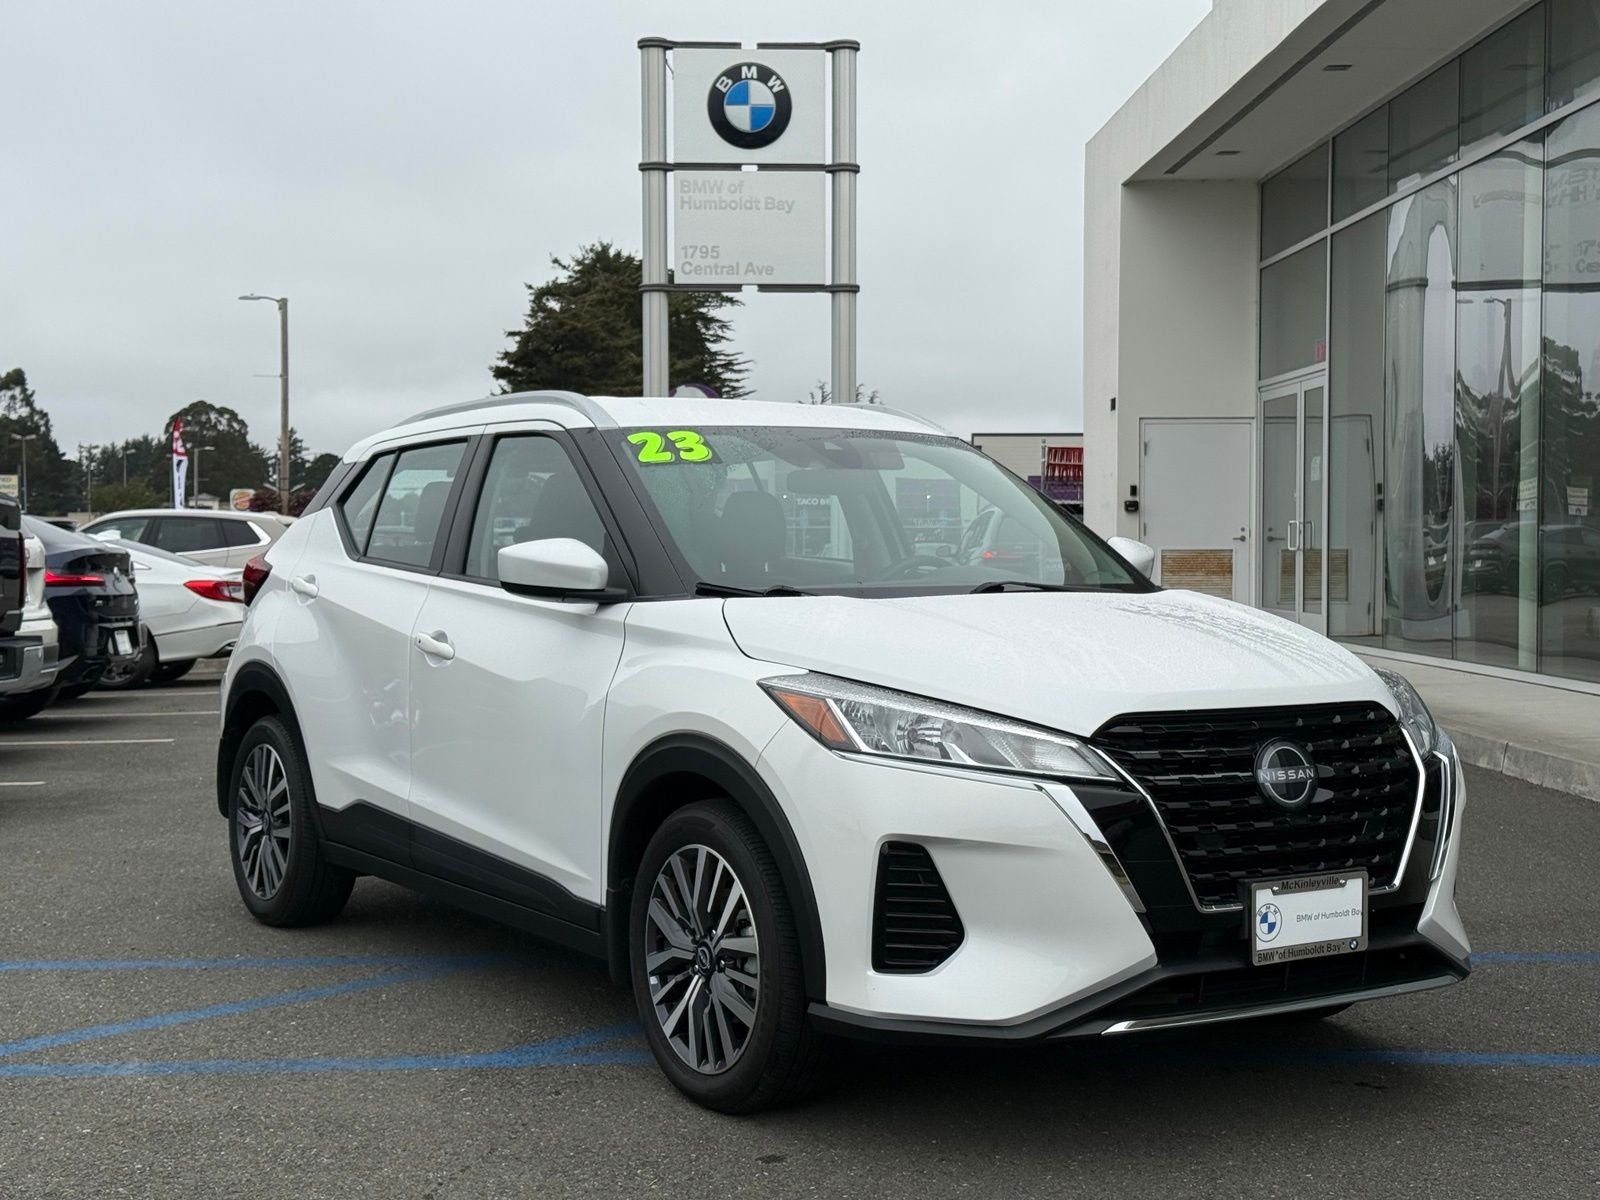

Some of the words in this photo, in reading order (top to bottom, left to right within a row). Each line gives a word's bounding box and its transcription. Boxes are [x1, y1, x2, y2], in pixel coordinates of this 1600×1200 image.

[715, 65, 784, 93] BMW
[680, 180, 723, 194] BMW
[727, 180, 744, 194] of
[680, 196, 760, 211] Humboldt
[764, 196, 795, 214] Bay
[681, 245, 720, 259] 1795
[681, 262, 739, 276] Central
[744, 262, 774, 276] Ave
[627, 430, 712, 463] 23
[797, 497, 818, 505] TACO
[1260, 768, 1314, 781] NISSAN
[1281, 876, 1340, 890] McKinleyville
[1296, 914, 1313, 923] BMW
[1314, 912, 1321, 920] of
[1322, 909, 1350, 919] Humboldt
[1279, 949, 1286, 959] of
[1287, 945, 1325, 958] Humboldt
[1327, 943, 1341, 953] Bay
